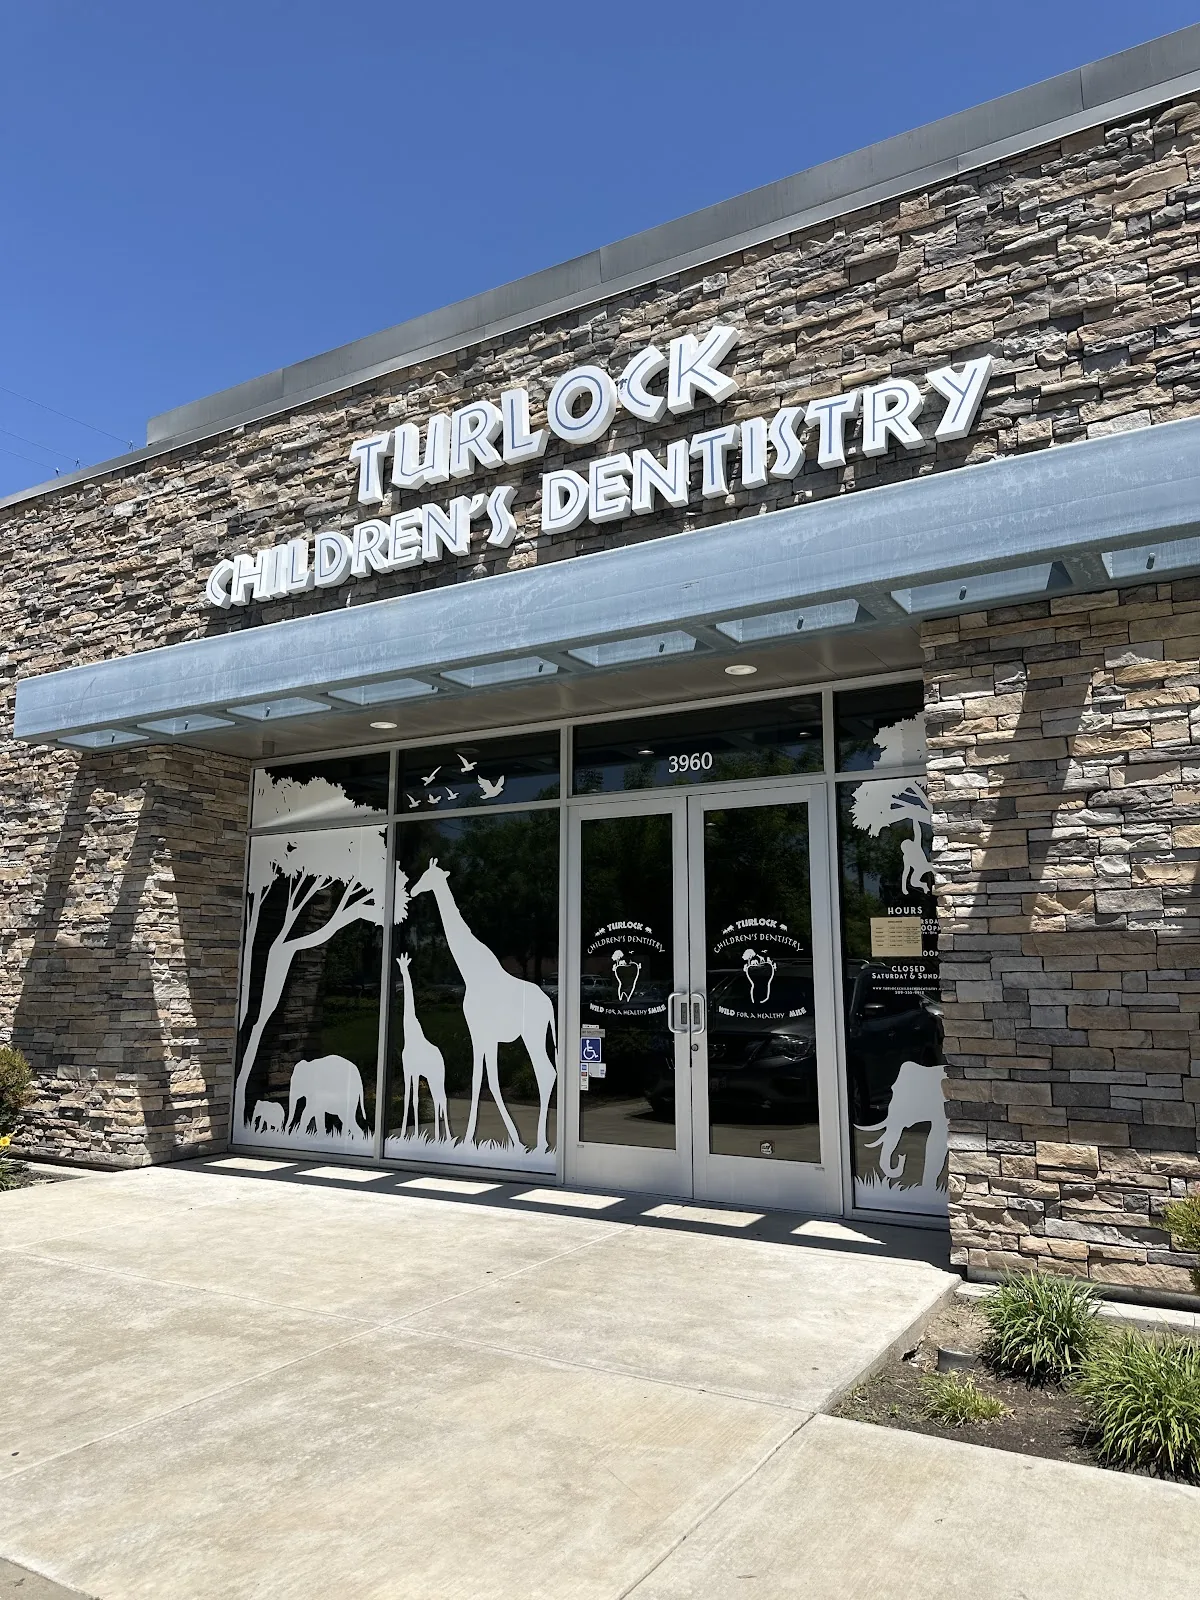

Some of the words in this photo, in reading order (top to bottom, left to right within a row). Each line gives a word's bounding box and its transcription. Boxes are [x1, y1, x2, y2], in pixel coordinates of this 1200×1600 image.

[350, 325, 740, 505] TURLOCK
[206, 484, 519, 609] CHILDREN'S
[541, 354, 993, 535] DENTISTRY
[668, 751, 713, 773] 3960
[887, 906, 923, 915] HOURS
[606, 921, 644, 931] TURLOCK
[735, 918, 778, 929] TURLOCK
[587, 935, 626, 954] CHILDREN'S
[627, 935, 666, 953] DENTISTRY
[713, 933, 758, 954] CHILDREN'S
[759, 933, 804, 952] DENTISTRY
[891, 965, 926, 973] CLOSED
[909, 972, 916, 980] &
[589, 1002, 605, 1013] WILD
[647, 1003, 667, 1015] SMILE
[718, 1005, 736, 1017] WILD
[736, 1011, 750, 1019] FOR
